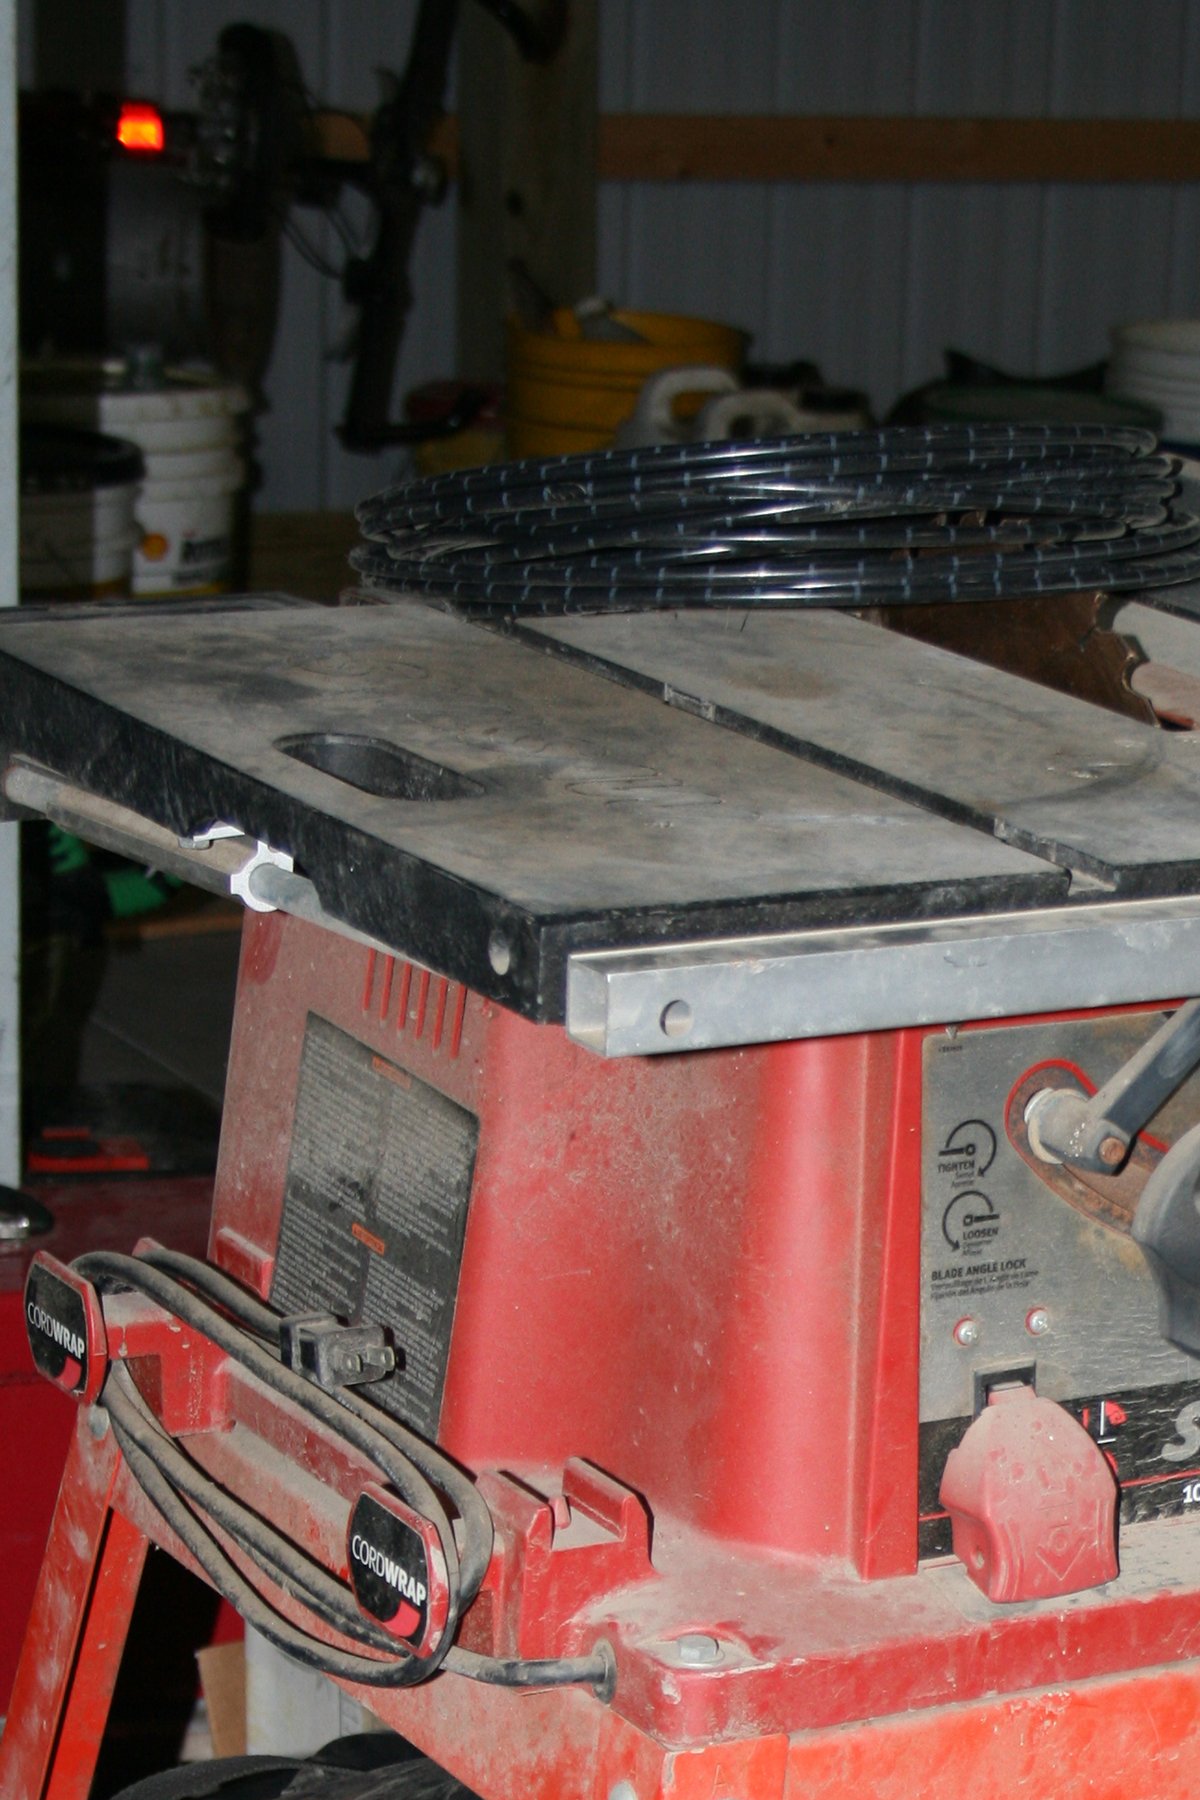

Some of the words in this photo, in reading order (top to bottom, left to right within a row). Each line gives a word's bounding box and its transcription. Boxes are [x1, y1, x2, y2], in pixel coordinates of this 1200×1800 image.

[938, 1160, 975, 1173] TIGHTEN
[963, 1227, 999, 1241] LOOSEN
[931, 1267, 963, 1281] BLADE
[966, 1263, 998, 1276] ANGLE
[1000, 1258, 1026, 1271] LOCK
[27, 1302, 85, 1360] CORDWRAP
[352, 1534, 427, 1607] CORDWRAP
